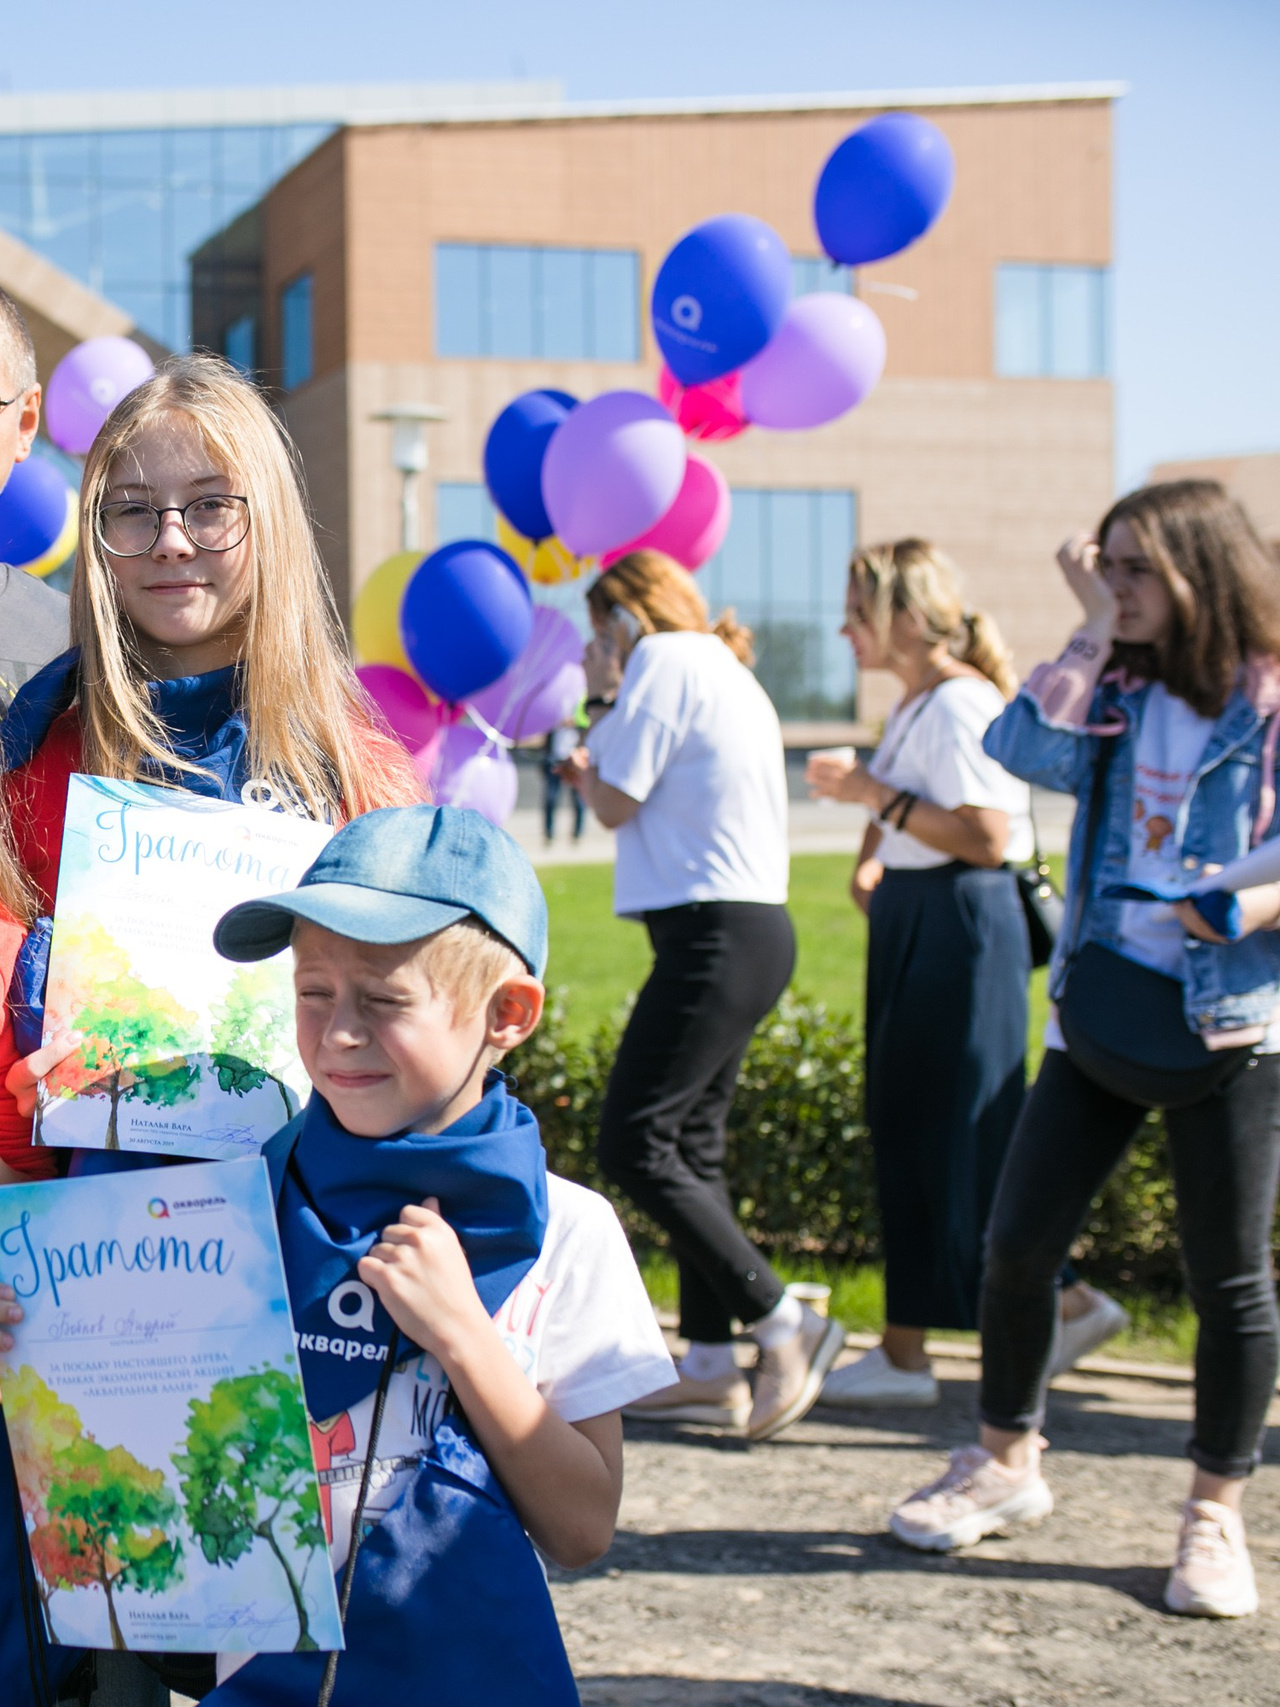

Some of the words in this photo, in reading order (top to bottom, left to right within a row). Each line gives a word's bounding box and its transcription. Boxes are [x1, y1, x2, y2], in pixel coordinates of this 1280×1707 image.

[95, 801, 291, 891] Грамота
[173, 1196, 227, 1211] акварель
[0, 1210, 235, 1307] Грамота
[294, 1331, 389, 1362] кварел
